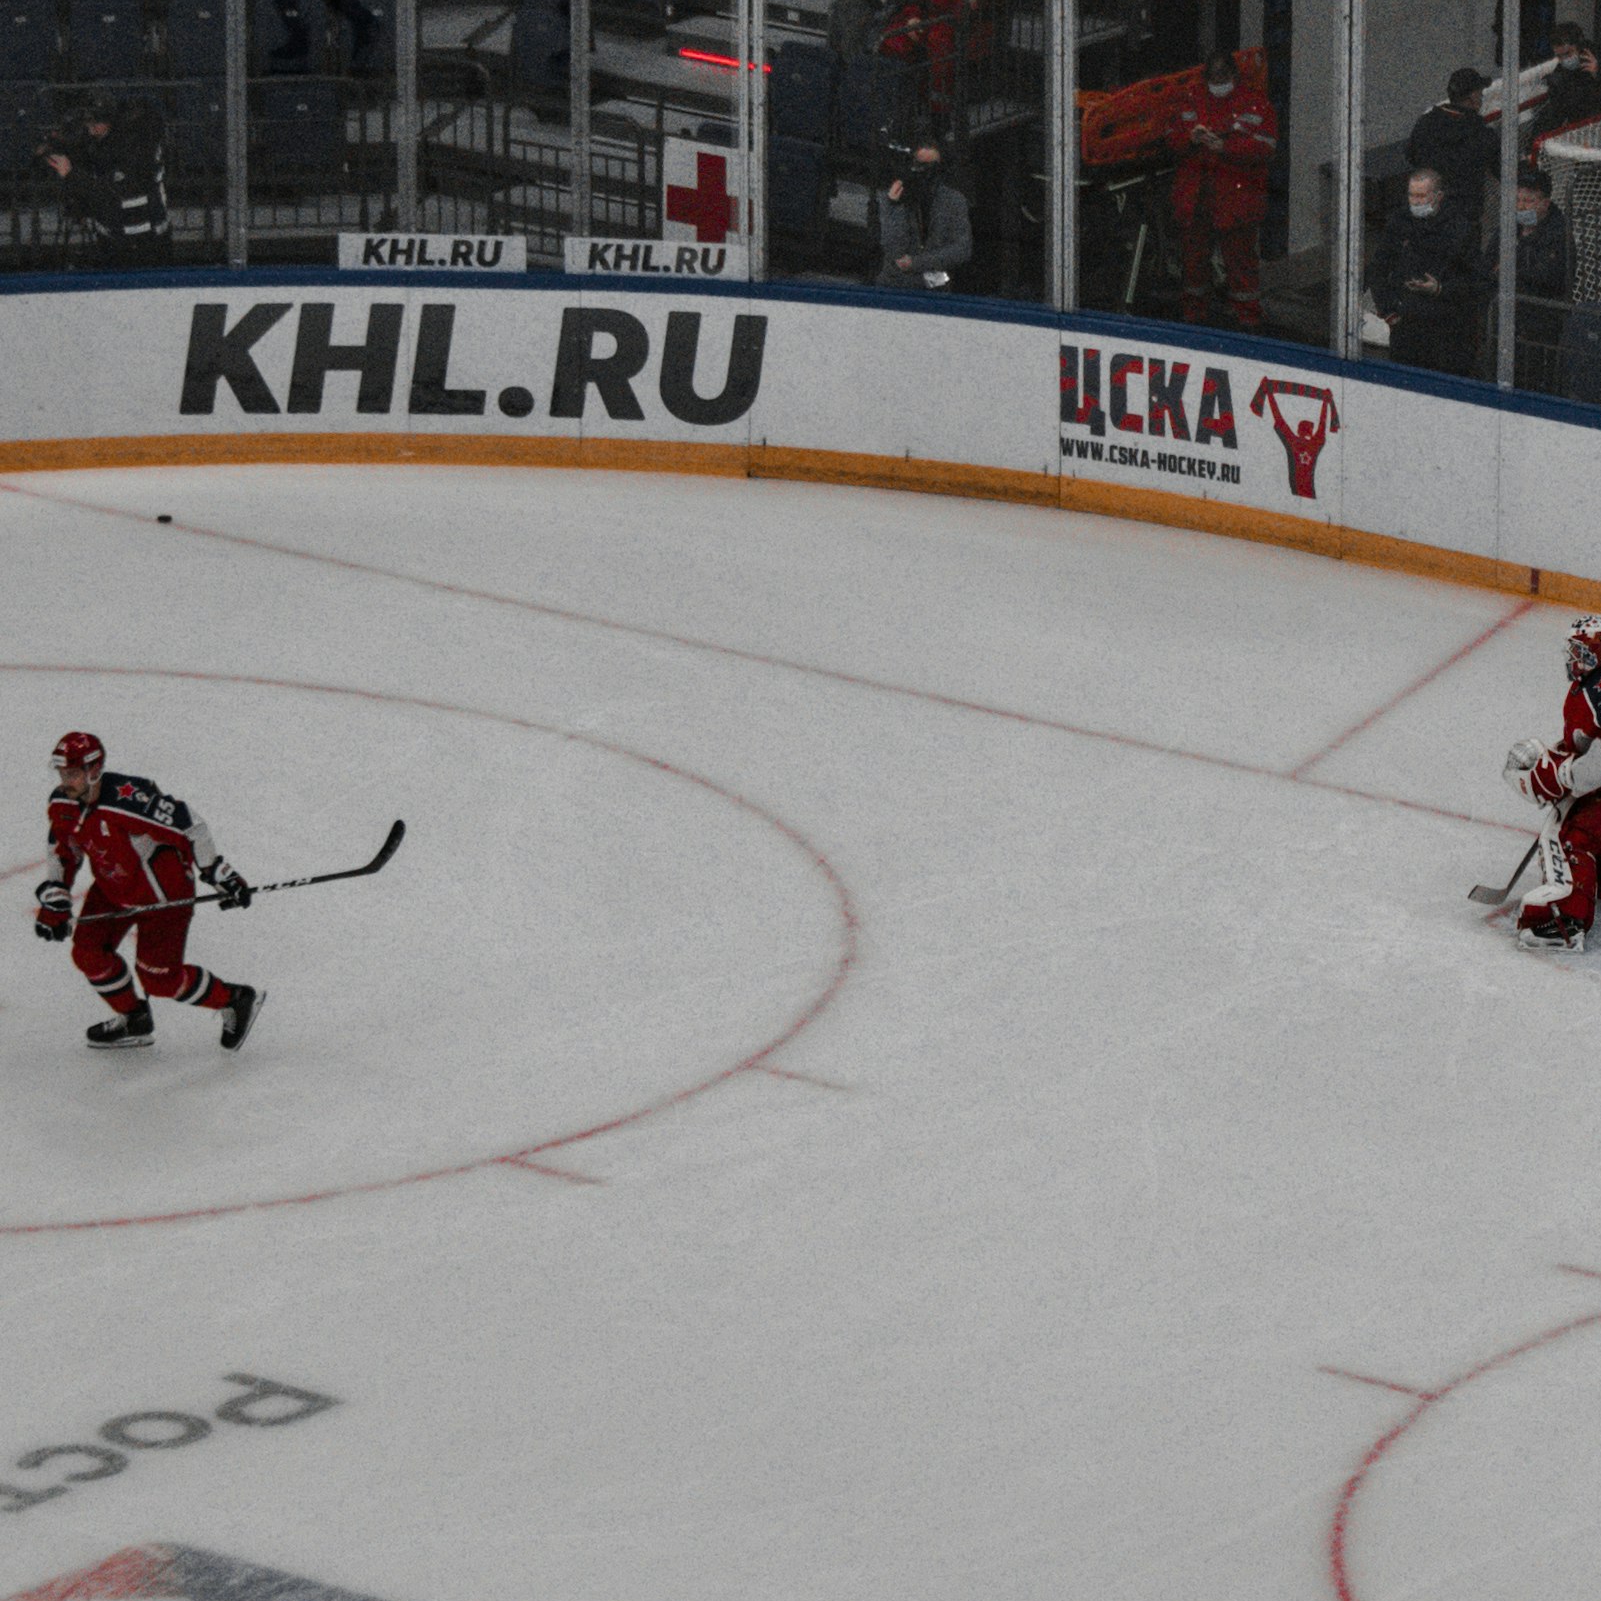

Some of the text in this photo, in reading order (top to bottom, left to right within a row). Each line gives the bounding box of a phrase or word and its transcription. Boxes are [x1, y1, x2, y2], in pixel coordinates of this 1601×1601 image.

[361, 237, 504, 267] KHL.RU
[587, 242, 727, 276] KHL.RU
[179, 302, 768, 425] KHL.RU
[1060, 345, 1238, 449] ЦСКА
[1060, 437, 1241, 484] WWW.CSKA-HOCKEY.RU
[153, 797, 177, 826] 55
[1548, 839, 1566, 886] CCM
